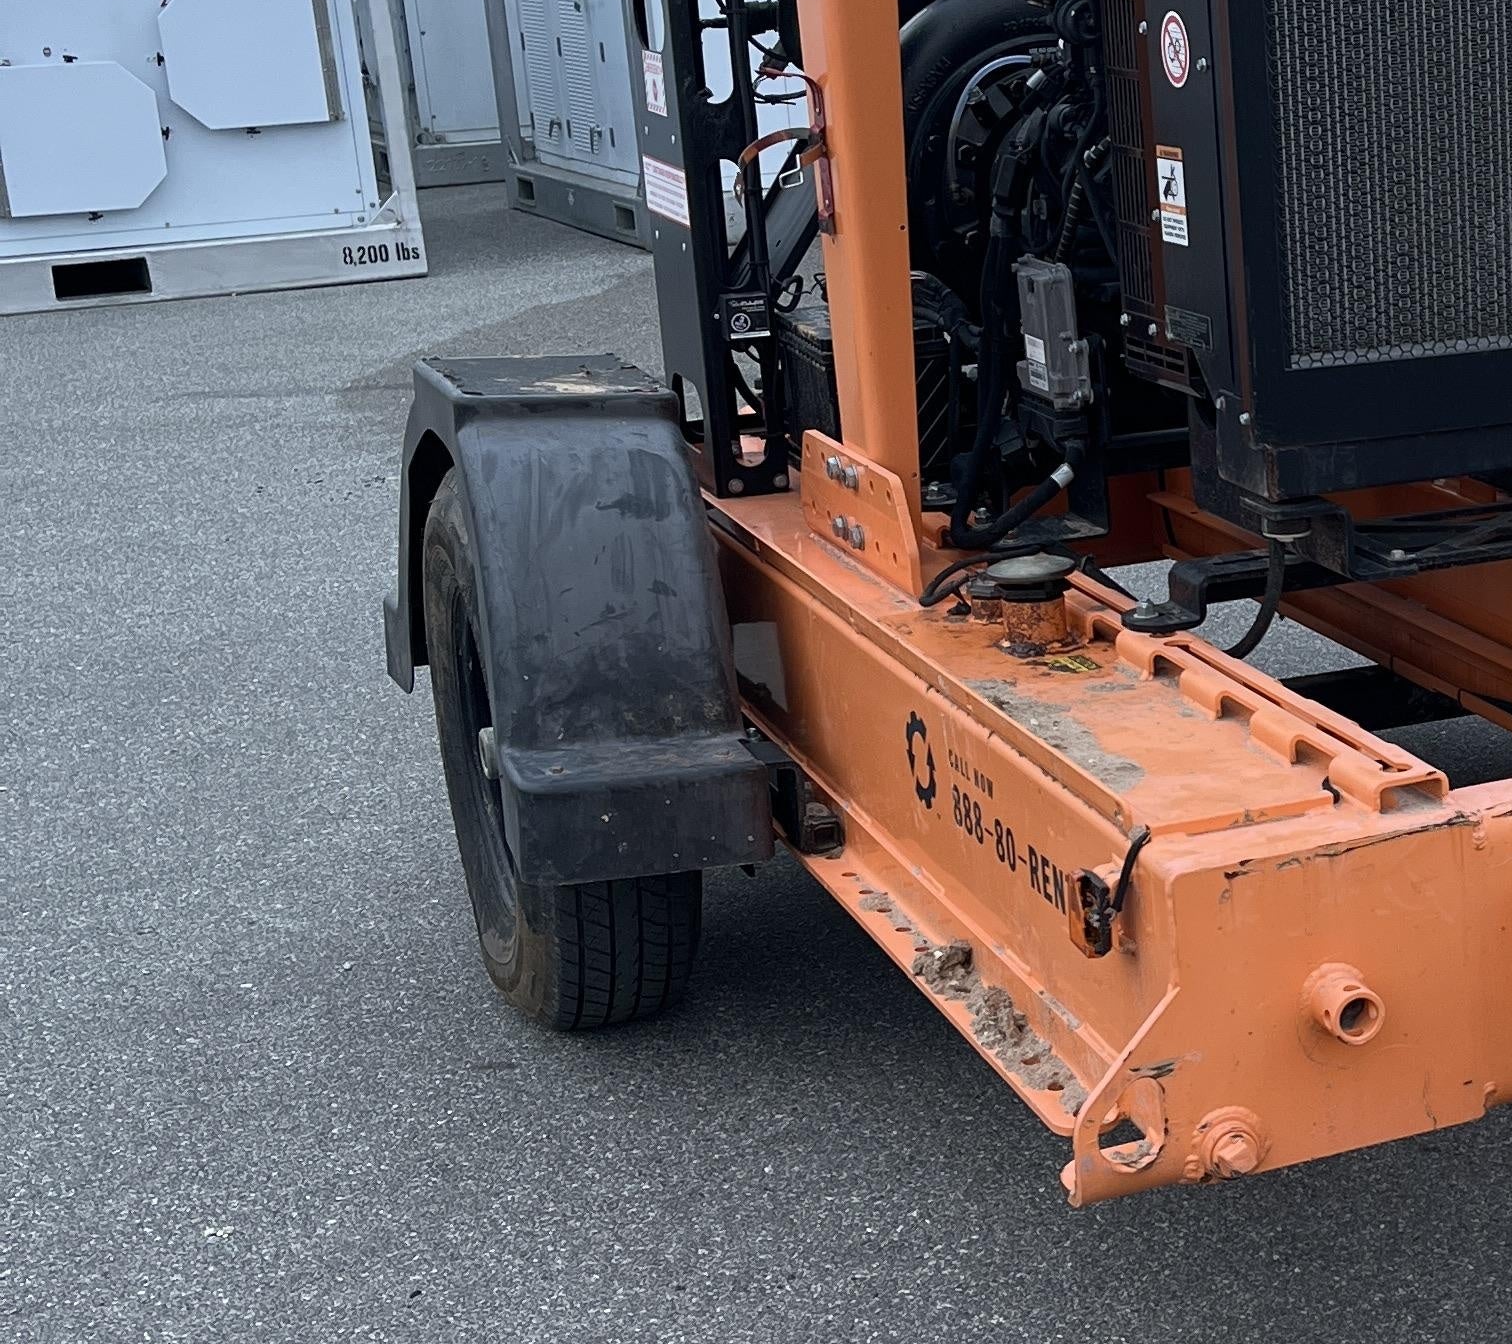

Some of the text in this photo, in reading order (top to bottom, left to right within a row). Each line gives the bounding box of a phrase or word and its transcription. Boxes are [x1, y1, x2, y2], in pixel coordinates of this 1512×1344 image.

[343, 241, 420, 267] 8,200 lbs
[948, 749, 994, 800] CALL NOW
[953, 783, 1068, 916] 888-80-REN
